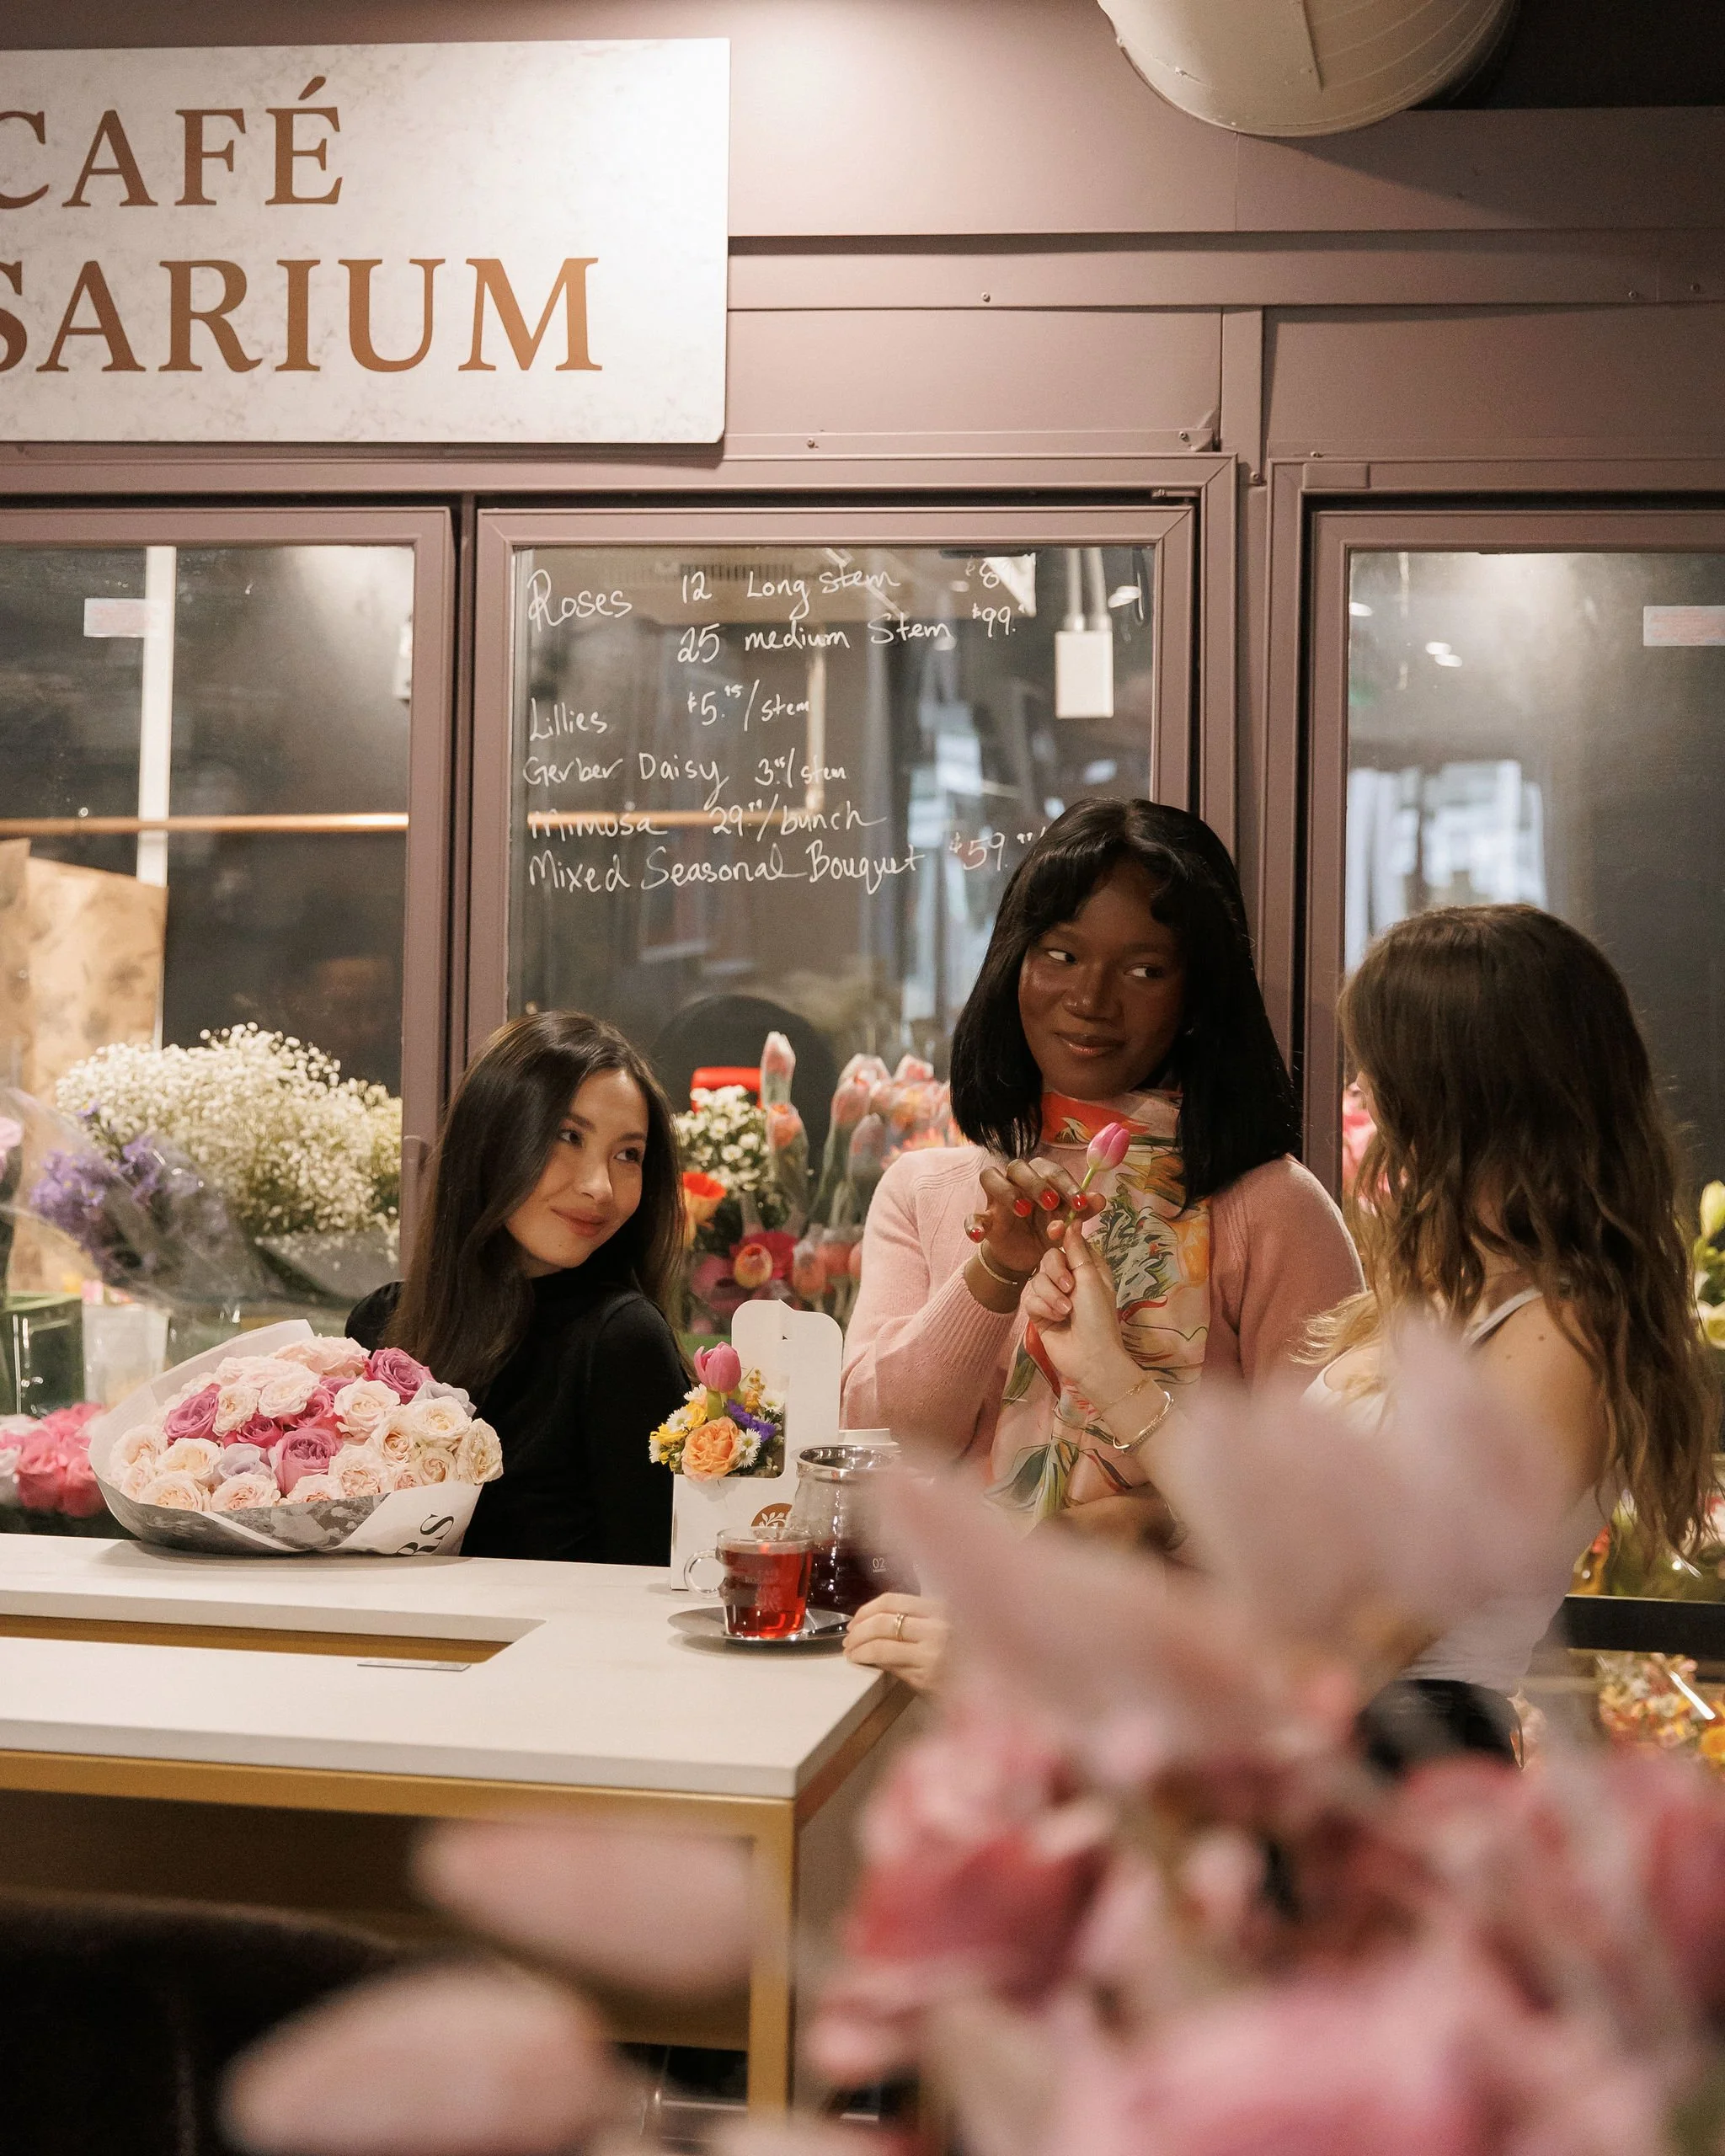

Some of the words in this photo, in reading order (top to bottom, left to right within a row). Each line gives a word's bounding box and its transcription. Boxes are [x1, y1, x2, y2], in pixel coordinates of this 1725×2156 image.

[527, 568, 633, 632] Roses
[681, 571, 713, 604] 12
[746, 570, 810, 621] Long
[677, 622, 721, 664] 25
[529, 696, 608, 742] Lillies
[638, 752, 730, 811] Daisy
[528, 849, 632, 893] Mixed
[641, 842, 807, 891] Seasonal
[806, 839, 926, 895] Bouquet
